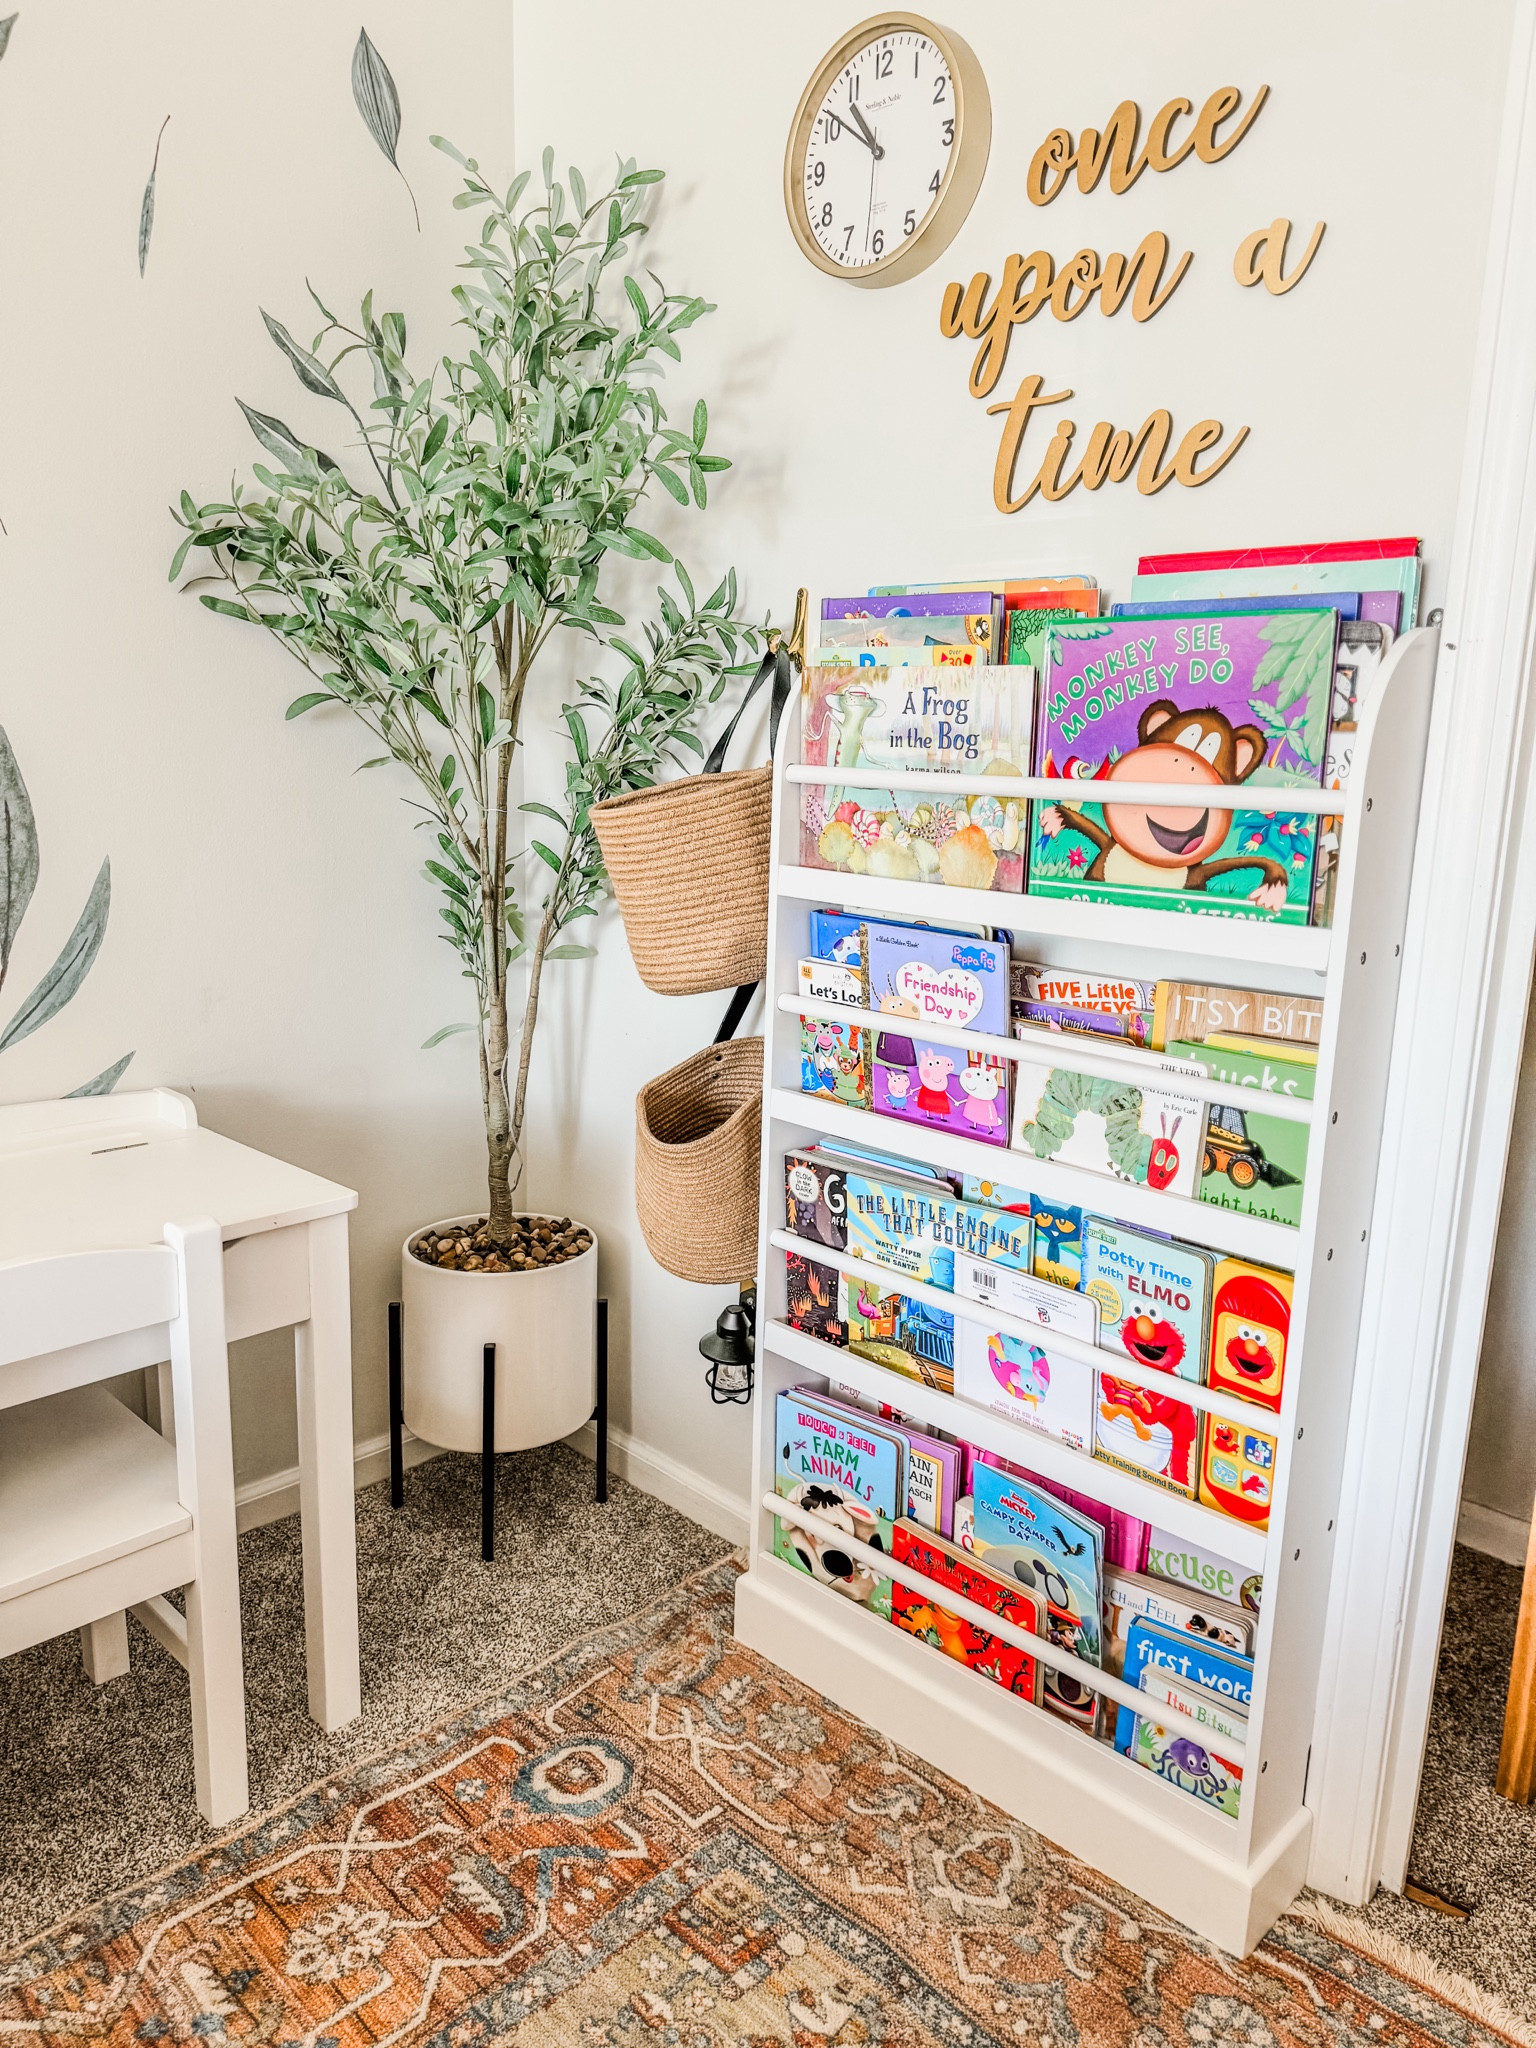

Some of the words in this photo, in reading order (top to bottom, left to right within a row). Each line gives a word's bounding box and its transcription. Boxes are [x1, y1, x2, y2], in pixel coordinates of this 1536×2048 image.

[876, 49, 894, 80] 12
[848, 74, 860, 103] 11
[932, 76, 946, 105] 2
[824, 115, 841, 144] 10
[941, 118, 955, 147] 3
[1026, 84, 1271, 206] once
[813, 161, 826, 187] 9
[928, 169, 942, 196] 4
[821, 202, 833, 228] 8
[903, 208, 916, 236] 5
[843, 224, 855, 252] 7
[872, 229, 884, 255] 6
[940, 230, 1195, 399] upon
[1233, 217, 1327, 295] a
[986, 375, 1251, 515] time
[1046, 636, 1158, 723] MONKEY
[1174, 623, 1231, 656] SEE,
[901, 691, 916, 715] A
[922, 686, 970, 725] Frog
[1059, 660, 1179, 744] MONKEY
[1188, 657, 1235, 684] DO
[889, 730, 903, 748] in
[907, 728, 932, 749] the
[937, 721, 980, 760] Bog
[952, 946, 980, 967] Peppa
[980, 951, 995, 970] Pig
[810, 983, 838, 1000] Let's
[904, 971, 977, 1006] Friendship
[1037, 981, 1082, 1001] FIVE
[1086, 983, 1136, 1000] Little
[924, 995, 953, 1020] Day
[1174, 994, 1249, 1029] ITSY
[1160, 1063, 1178, 1072] THE
[1210, 1124, 1245, 1144] ROBOT
[857, 1194, 885, 1214] THE
[891, 1196, 947, 1226] LITTLE
[955, 1211, 1023, 1259] ENGINE
[882, 1213, 925, 1237] THAT
[932, 1222, 988, 1258] COULD
[875, 1239, 899, 1251] WATTY
[900, 1247, 922, 1259] PIPER
[876, 1254, 891, 1263] DAN
[892, 1259, 920, 1272] SANTAT
[1045, 1269, 1070, 1287] the
[1098, 1243, 1146, 1275] Potty
[1149, 1261, 1193, 1289] Time
[1097, 1264, 1124, 1281] with
[1127, 1274, 1191, 1312] ELMO
[799, 1413, 836, 1438] TOUCH
[847, 1432, 875, 1456] FEEL
[813, 1436, 859, 1471] FARM
[801, 1454, 875, 1502] ANIMALS
[1111, 1455, 1141, 1478] Training
[1142, 1470, 1167, 1487] Sound
[1168, 1482, 1188, 1498] Book
[999, 1496, 1036, 1522] MICKEY
[980, 1500, 1015, 1524] CAMPY
[1018, 1521, 1057, 1552] CAMPER
[1008, 1524, 1031, 1542] DAY
[1127, 1599, 1143, 1611] and
[1145, 1597, 1180, 1625] FEEL
[1136, 1639, 1192, 1677] first
